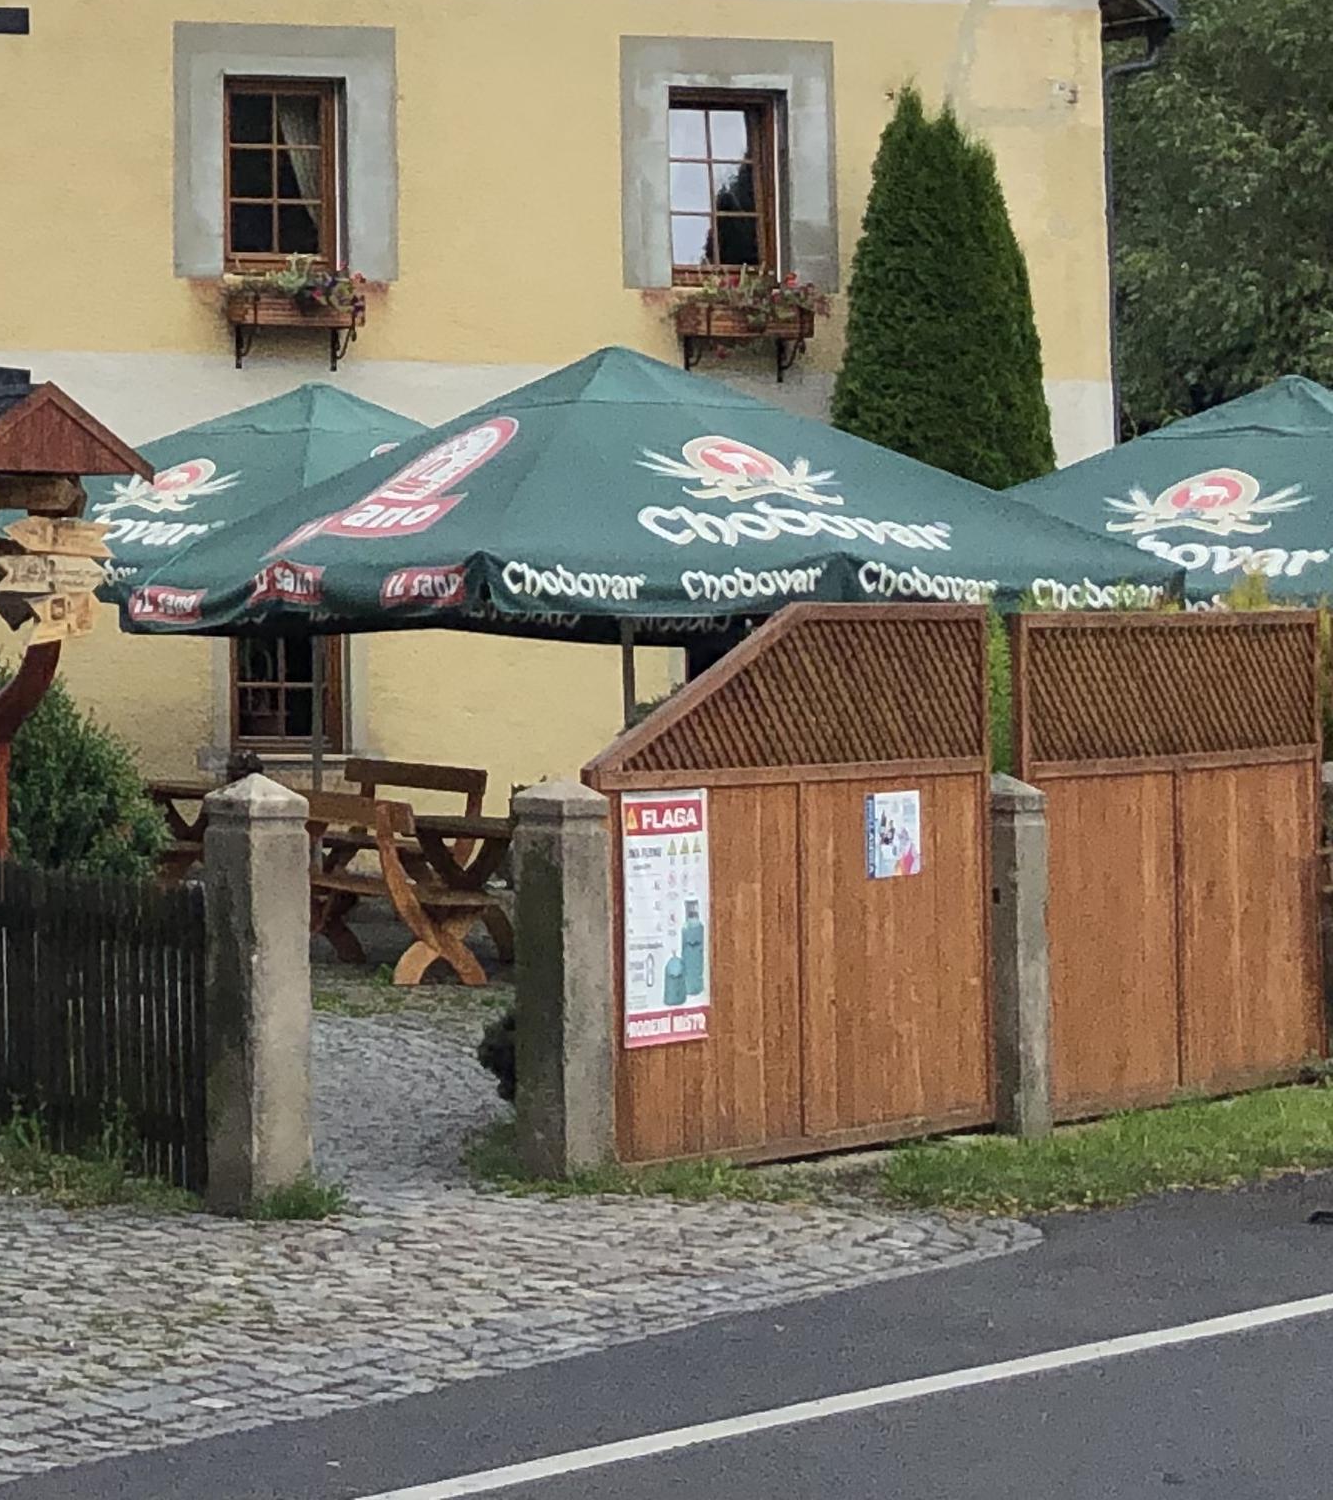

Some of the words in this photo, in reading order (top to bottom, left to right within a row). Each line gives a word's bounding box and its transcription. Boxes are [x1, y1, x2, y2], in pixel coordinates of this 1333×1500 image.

[637, 500, 952, 551] Chodovar
[501, 560, 645, 601] Chodovar
[681, 564, 822, 602] Chodovar
[857, 560, 997, 604] Chodovar
[641, 806, 699, 830] FLAGA
